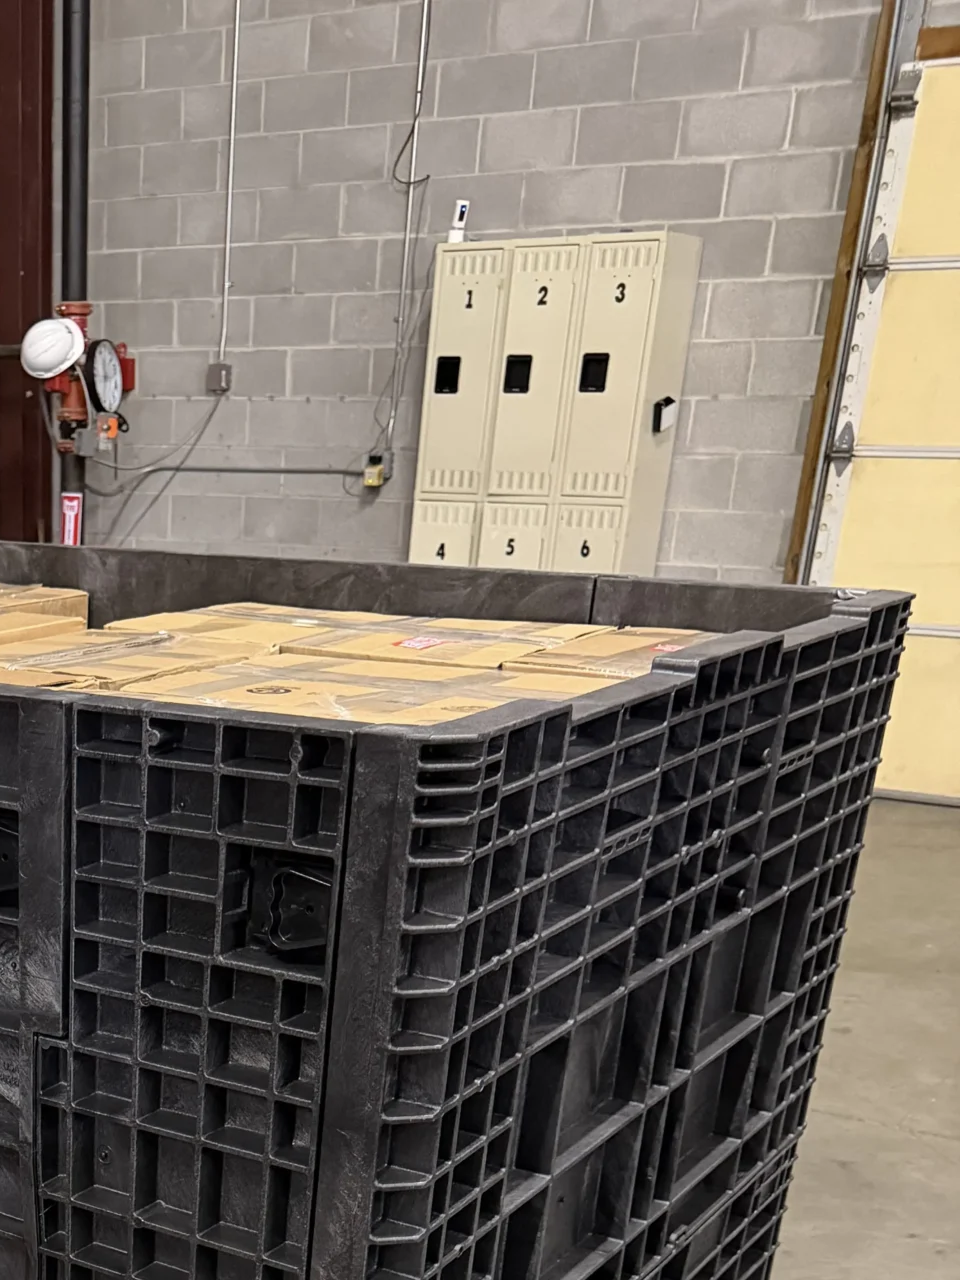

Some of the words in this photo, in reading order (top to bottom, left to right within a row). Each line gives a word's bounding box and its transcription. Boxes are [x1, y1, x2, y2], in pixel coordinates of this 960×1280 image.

[465, 290, 473, 308] 1
[537, 286, 548, 305] 2
[615, 283, 626, 302] 3
[436, 543, 445, 560] 4
[505, 538, 515, 556] 5
[580, 540, 590, 557] 6
